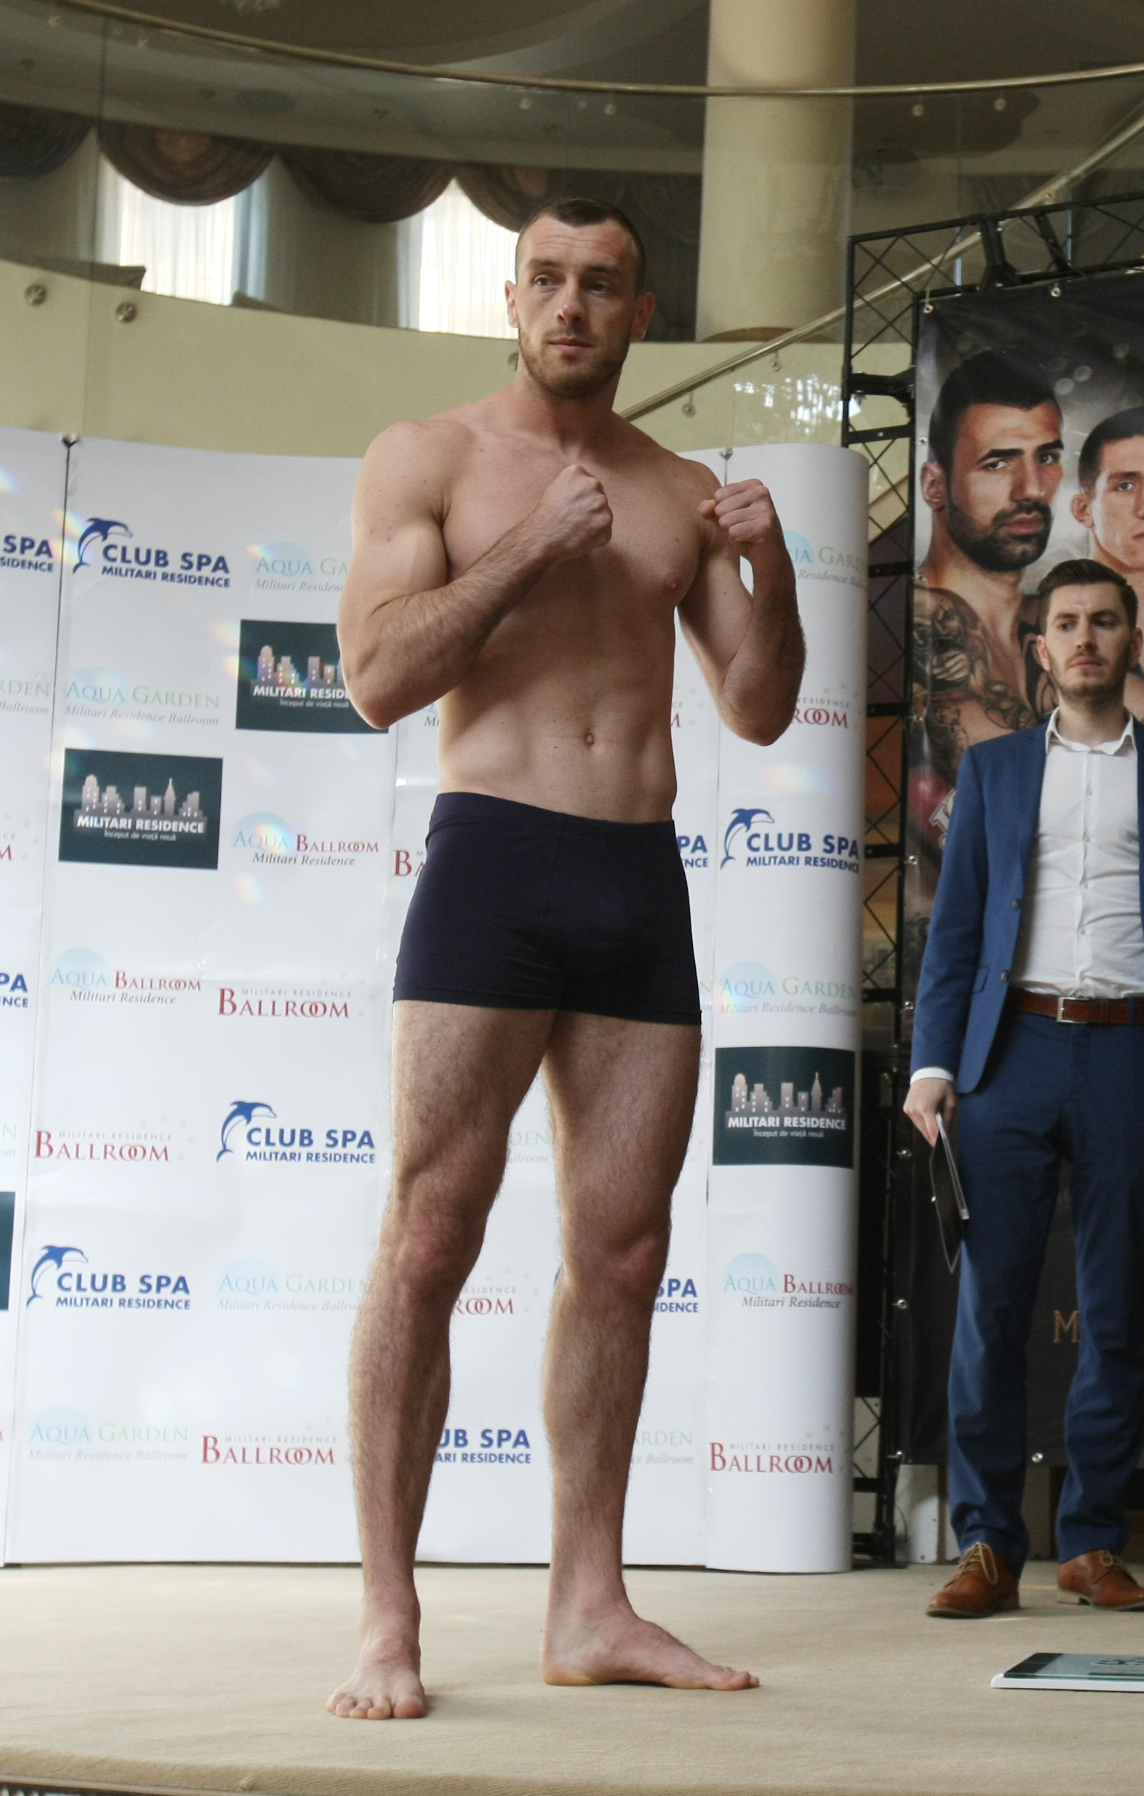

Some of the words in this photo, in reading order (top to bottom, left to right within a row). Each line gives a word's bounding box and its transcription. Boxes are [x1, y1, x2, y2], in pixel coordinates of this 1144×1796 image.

[3, 535, 54, 558] SPA
[0, 557, 54, 573] SIDENCE
[102, 544, 169, 568] CLUB
[180, 552, 230, 574] SPA
[256, 556, 313, 577] AQUA
[101, 566, 157, 580] MILITARI
[161, 572, 230, 588] RESIDENCE
[255, 580, 296, 591] Militari
[300, 582, 344, 592] Residen
[66, 681, 125, 705] AQUA
[133, 686, 220, 708] GARDEN
[253, 686, 306, 698] MILITARI
[310, 688, 349, 699] RESID
[797, 697, 850, 708] ESIDENCE
[64, 705, 107, 718] Militari
[110, 708, 165, 722] Residence
[168, 710, 219, 725] Ballroom
[793, 708, 848, 728] ROOM
[77, 815, 131, 829] MILITARI
[136, 818, 204, 833] RESIDENCE
[233, 831, 291, 852] AQUA
[296, 835, 379, 854] BALLROOM
[676, 835, 708, 853] PA
[746, 833, 812, 852] CLUB
[823, 834, 859, 859] SPA
[252, 852, 297, 865] Militari
[301, 855, 356, 867] Residence
[746, 856, 800, 867] MILITARI
[0, 973, 28, 993] PA
[51, 967, 108, 986] AQUA
[115, 971, 201, 991] BALLROOM
[721, 978, 775, 998] AQUA
[70, 990, 115, 1002] Militari
[120, 992, 176, 1005] Residence
[218, 987, 350, 1018] BALLROOM
[242, 988, 288, 996] MILITARI
[293, 990, 352, 998] RESIDENCE
[719, 1003, 759, 1014] Militari
[762, 1003, 815, 1014] Residence
[728, 1115, 780, 1128] MILITARI
[783, 1115, 846, 1130] RESIDENCE
[58, 1131, 105, 1139] MILITARI
[111, 1132, 172, 1141] RESIDENCE
[246, 1127, 314, 1148] CLUB
[325, 1129, 375, 1149] SPA
[34, 1130, 170, 1162] BALLROOM
[245, 1150, 301, 1162] MILITARI
[306, 1152, 375, 1164] RESIDENCE
[56, 1273, 126, 1293] CLUB
[139, 1275, 190, 1295] SPA
[219, 1274, 278, 1295] AQUA
[724, 1275, 777, 1295] AQUA
[56, 1296, 113, 1308] MILITARI
[118, 1298, 190, 1310] RESIDENCE
[452, 1297, 515, 1315] ROOM
[654, 1302, 698, 1313] IDENCE
[742, 1297, 785, 1307] Militari
[788, 1296, 841, 1309] Residence
[225, 1435, 272, 1443] MILITARI
[277, 1436, 337, 1444] RESIDENCE
[480, 1429, 530, 1449] SPA
[729, 1443, 772, 1451] MILITARI
[777, 1443, 835, 1452] RESIDENCE
[201, 1435, 336, 1465] BALLROOM
[461, 1453, 531, 1464] RESIDENCE
[709, 1442, 834, 1474] BALLROOM
